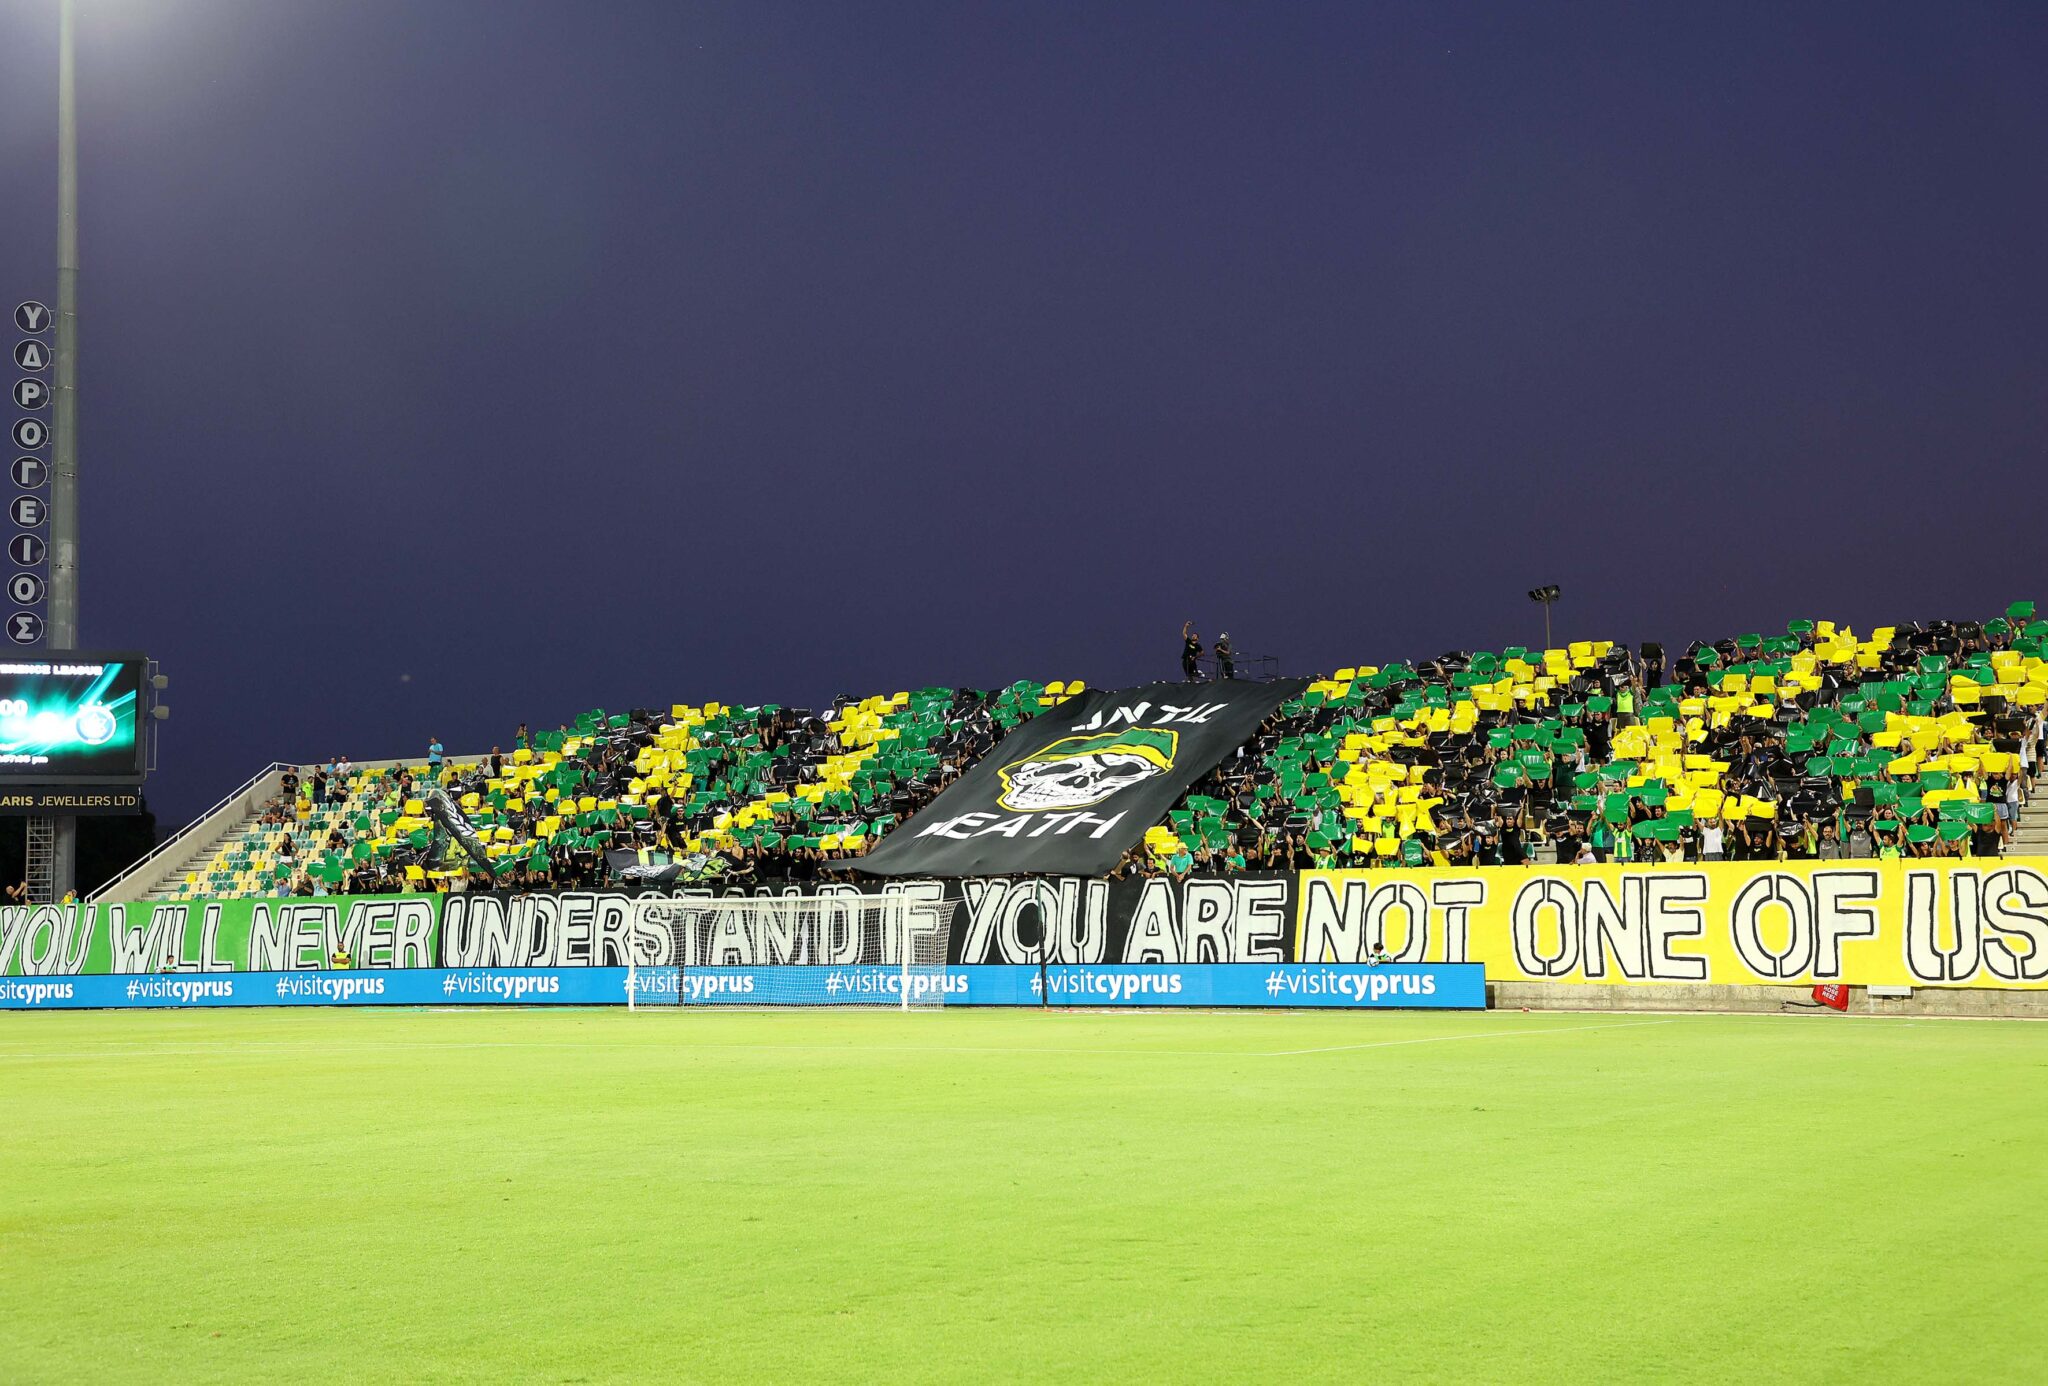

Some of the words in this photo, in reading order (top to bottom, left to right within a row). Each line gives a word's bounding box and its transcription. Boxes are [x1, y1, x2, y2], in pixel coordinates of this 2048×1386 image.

[0, 796, 33, 806] ARIS
[37, 796, 111, 806] JEWELLERS
[114, 796, 136, 806] LTD
[0, 903, 97, 976] YOU
[110, 902, 234, 974] WILL
[248, 899, 435, 970] NEVER
[440, 886, 868, 968] UNDERSTAND
[879, 882, 946, 966] IF
[960, 876, 1106, 965] YOU
[1121, 877, 1289, 965] ARE
[1301, 878, 1487, 964] NOT
[1511, 871, 1711, 981] ONE
[1730, 869, 1881, 980] OF
[1903, 867, 2048, 982] US
[126, 978, 233, 1004] #visitcyprus
[275, 976, 385, 1000] #visitcyprus
[442, 972, 560, 997] #visitcyprus
[624, 971, 755, 998] #visitcyprus
[825, 969, 969, 999] #visitcyprus
[1030, 968, 1182, 1000] #visitcyprus
[1265, 966, 1436, 1001] #visitcyprus
